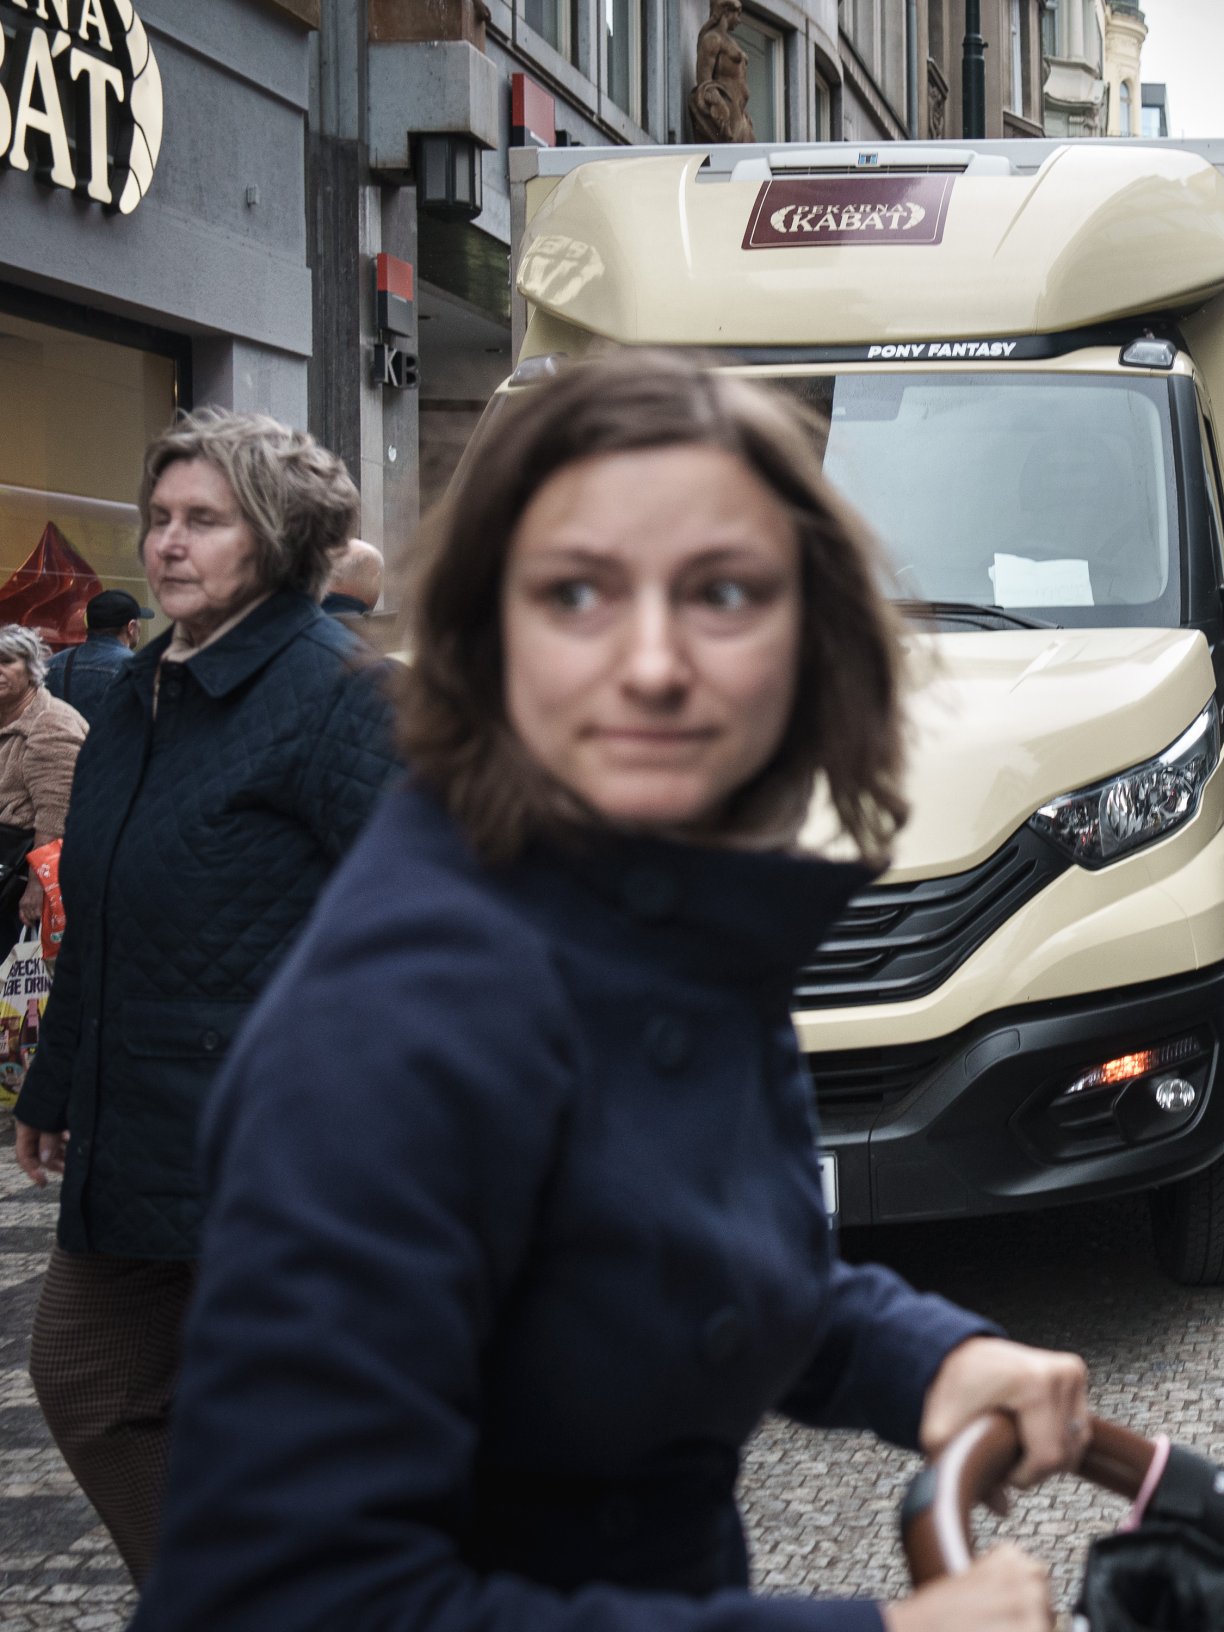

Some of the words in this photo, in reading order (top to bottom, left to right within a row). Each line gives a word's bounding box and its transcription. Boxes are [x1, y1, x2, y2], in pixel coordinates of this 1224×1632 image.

[0, 21, 124, 204] ÁT
[383, 343, 421, 389] KB
[867, 343, 926, 358] PONY
[927, 341, 1017, 357] FANTASY
